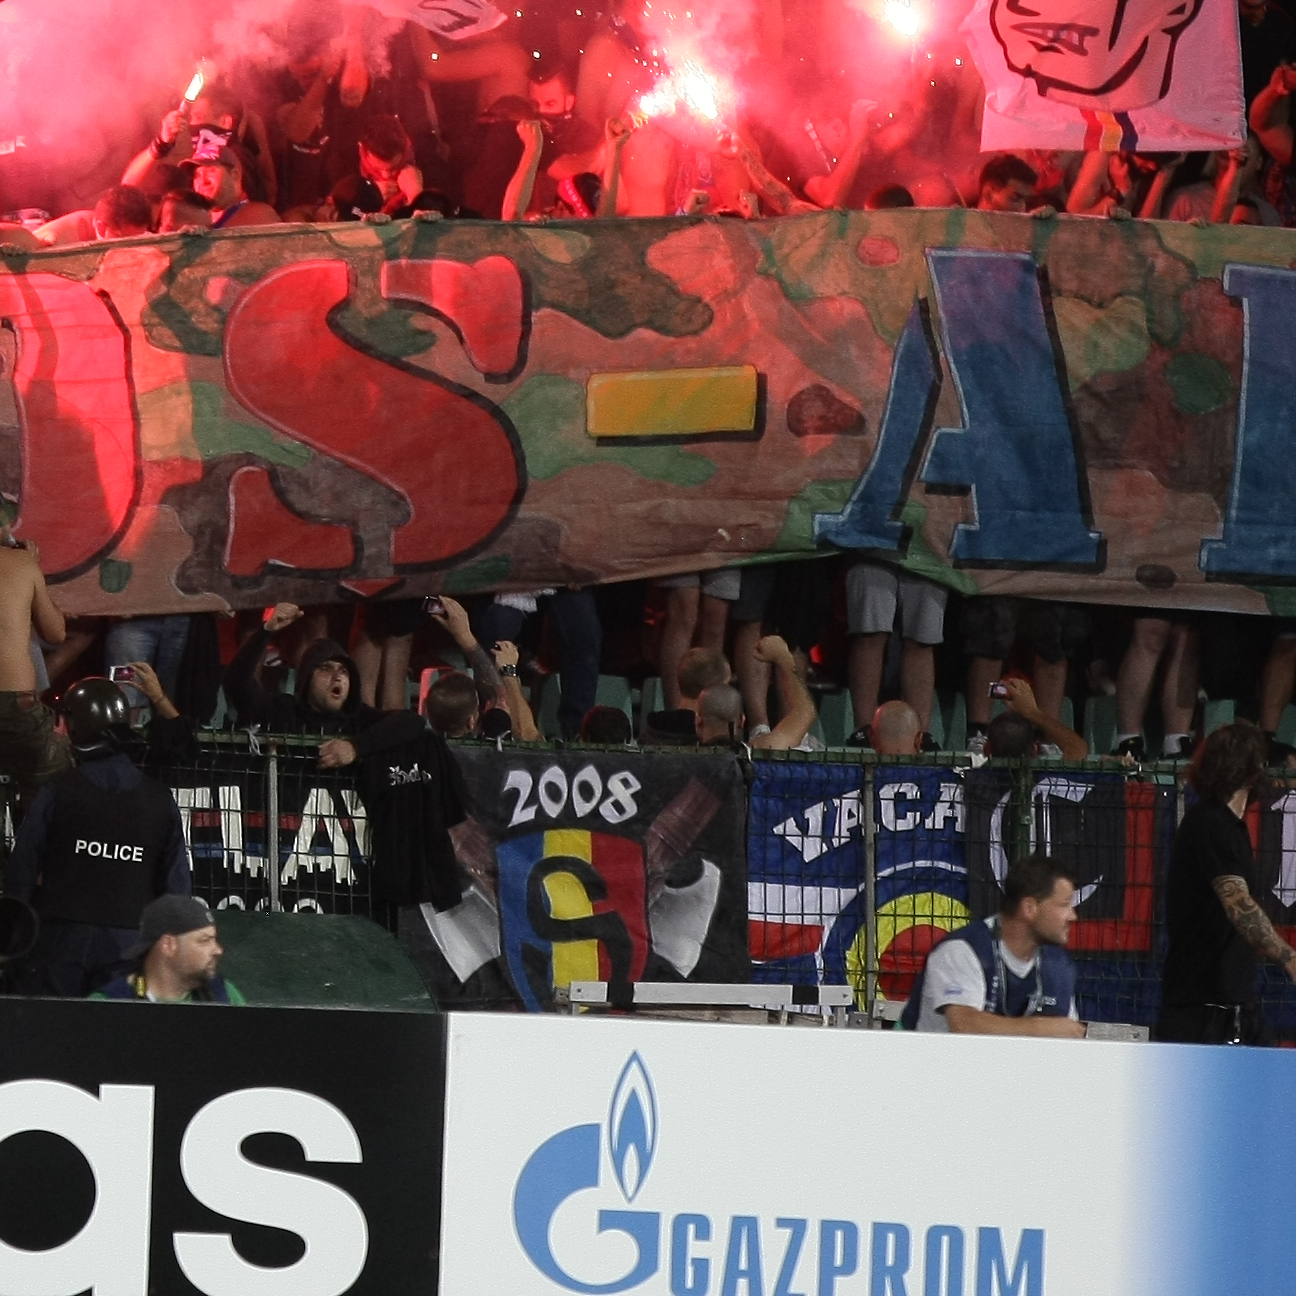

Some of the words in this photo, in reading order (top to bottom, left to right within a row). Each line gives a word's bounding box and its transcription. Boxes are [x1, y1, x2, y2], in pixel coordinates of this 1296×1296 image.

[503, 764, 642, 828] 2008
[74, 839, 145, 864] POLICE
[669, 1211, 1045, 1296] GAZPROM
